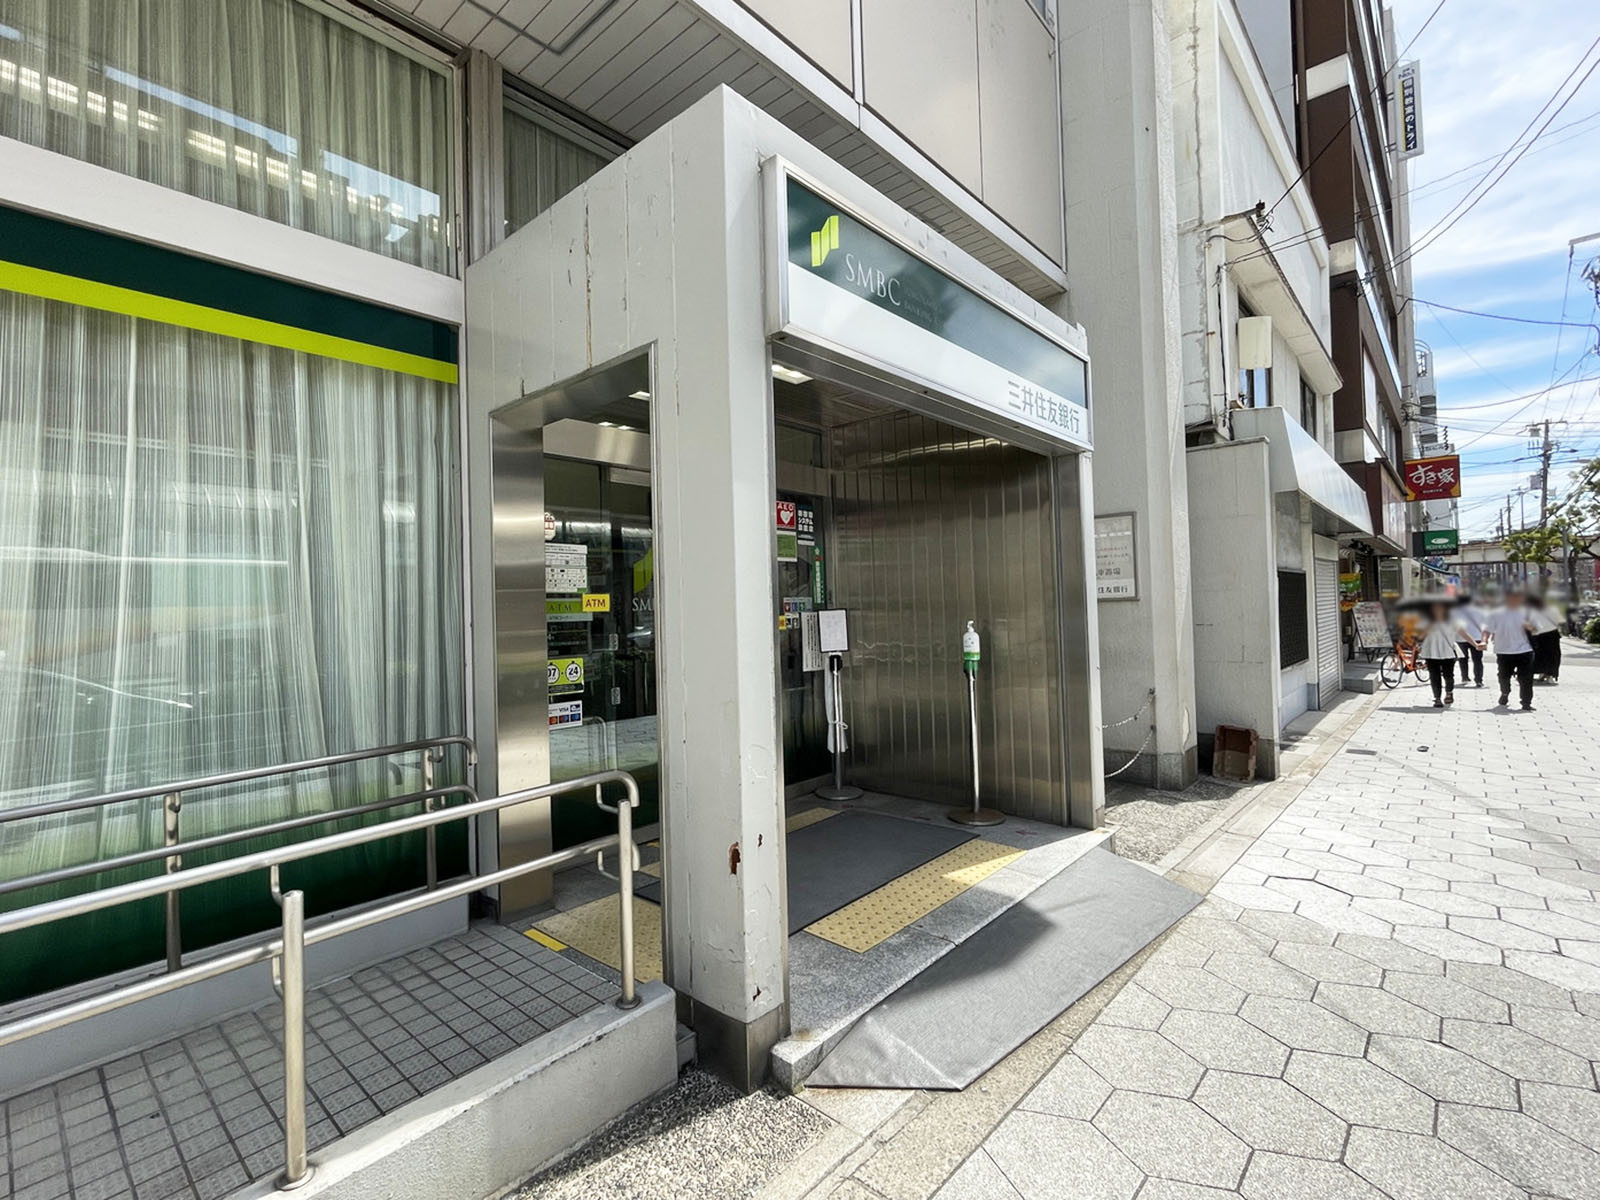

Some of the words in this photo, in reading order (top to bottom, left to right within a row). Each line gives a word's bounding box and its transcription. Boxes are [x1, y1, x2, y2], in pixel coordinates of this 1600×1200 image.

[845, 253, 901, 307] SMBC
[1008, 380, 1080, 434] 三井住友銀行
[1408, 464, 1455, 487] すき家
[585, 598, 606, 609] ATM
[632, 597, 654, 612] SM
[568, 666, 579, 677] 24
